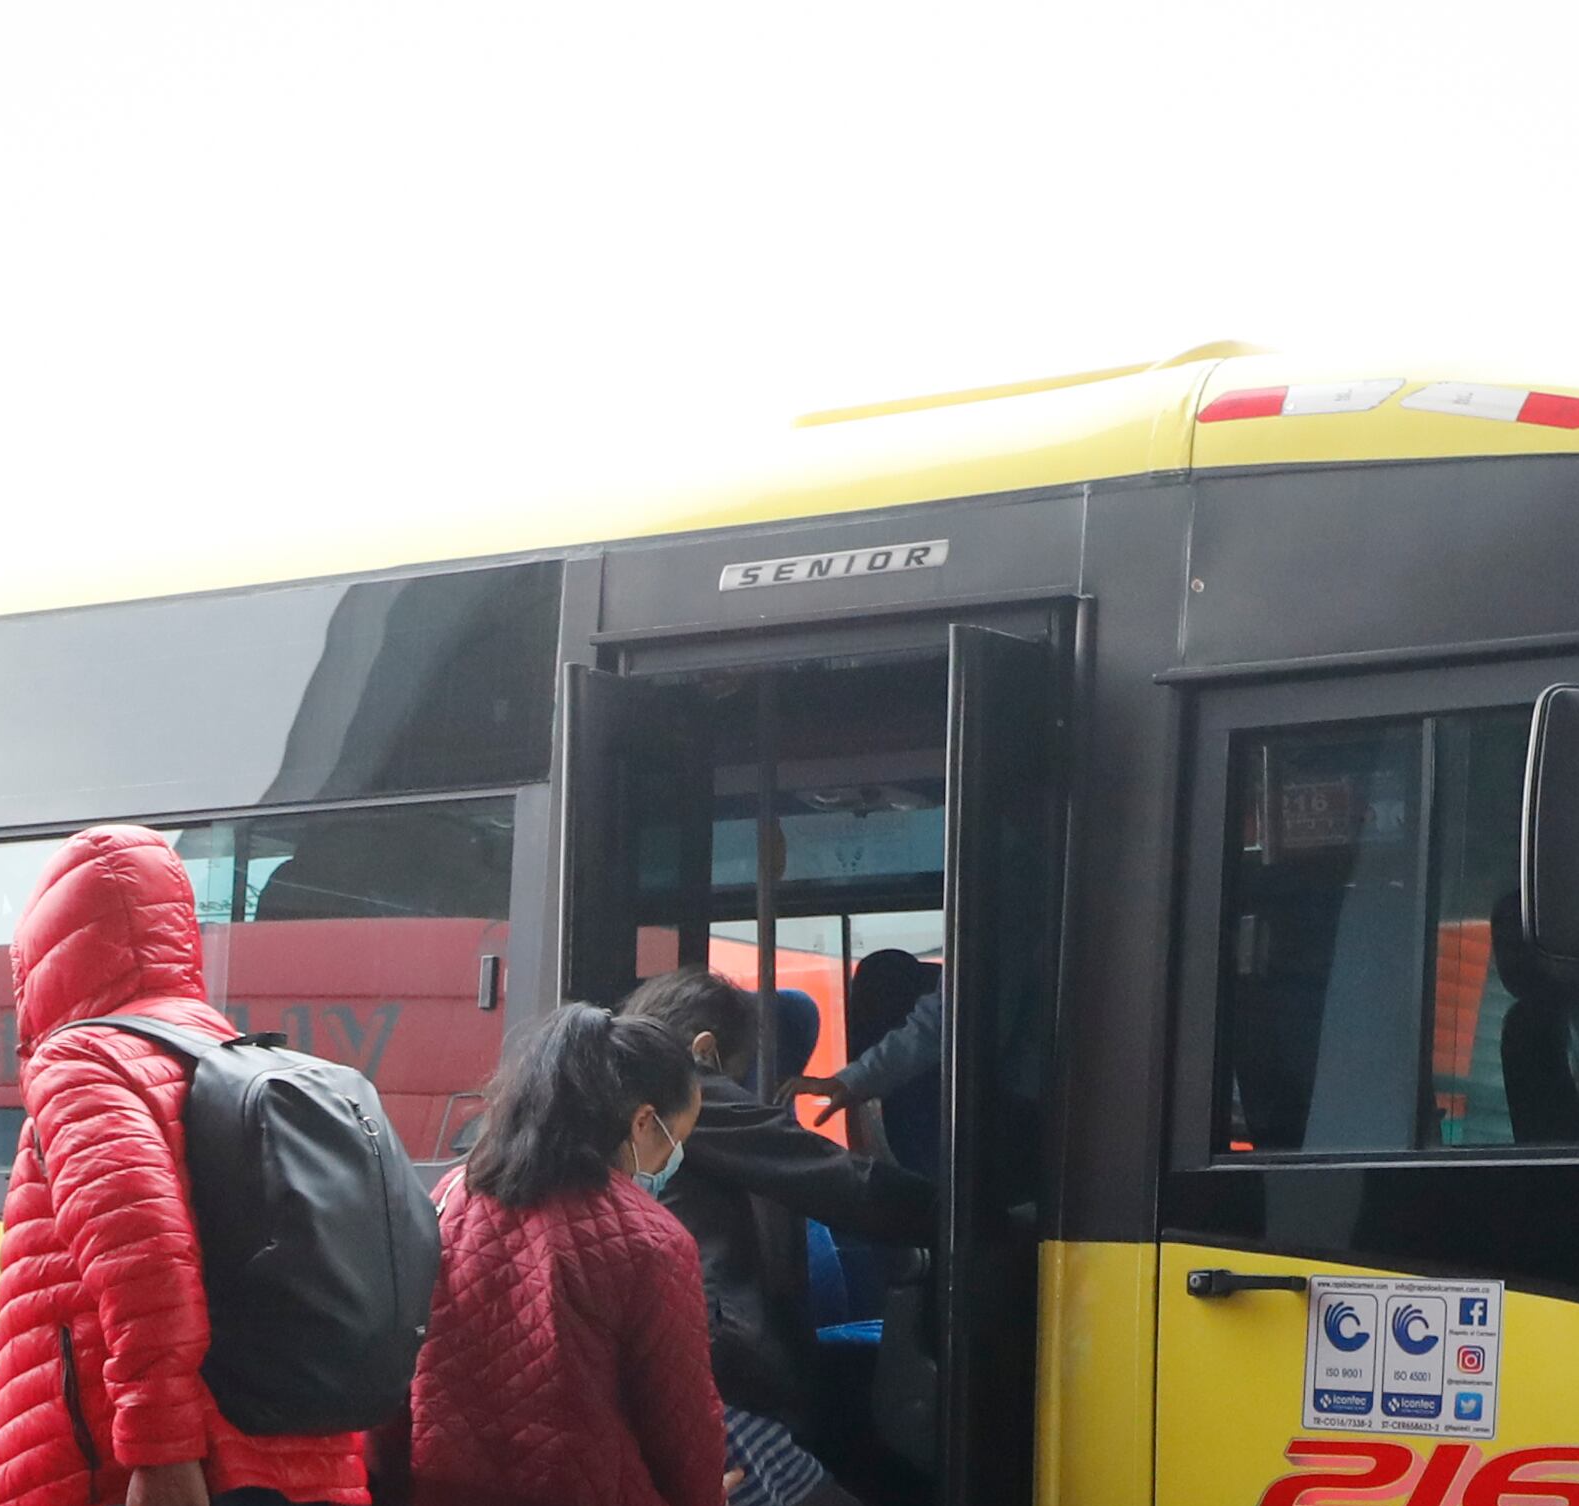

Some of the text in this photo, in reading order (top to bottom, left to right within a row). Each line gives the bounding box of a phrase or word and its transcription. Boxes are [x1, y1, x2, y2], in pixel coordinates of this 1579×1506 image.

[737, 546, 932, 587] SENIOR
[1325, 1368, 1363, 1379] ISO 9001
[1393, 1370, 1432, 1382] ISO 45001
[1331, 1394, 1367, 1407] icontec
[1399, 1397, 1436, 1411] icontec
